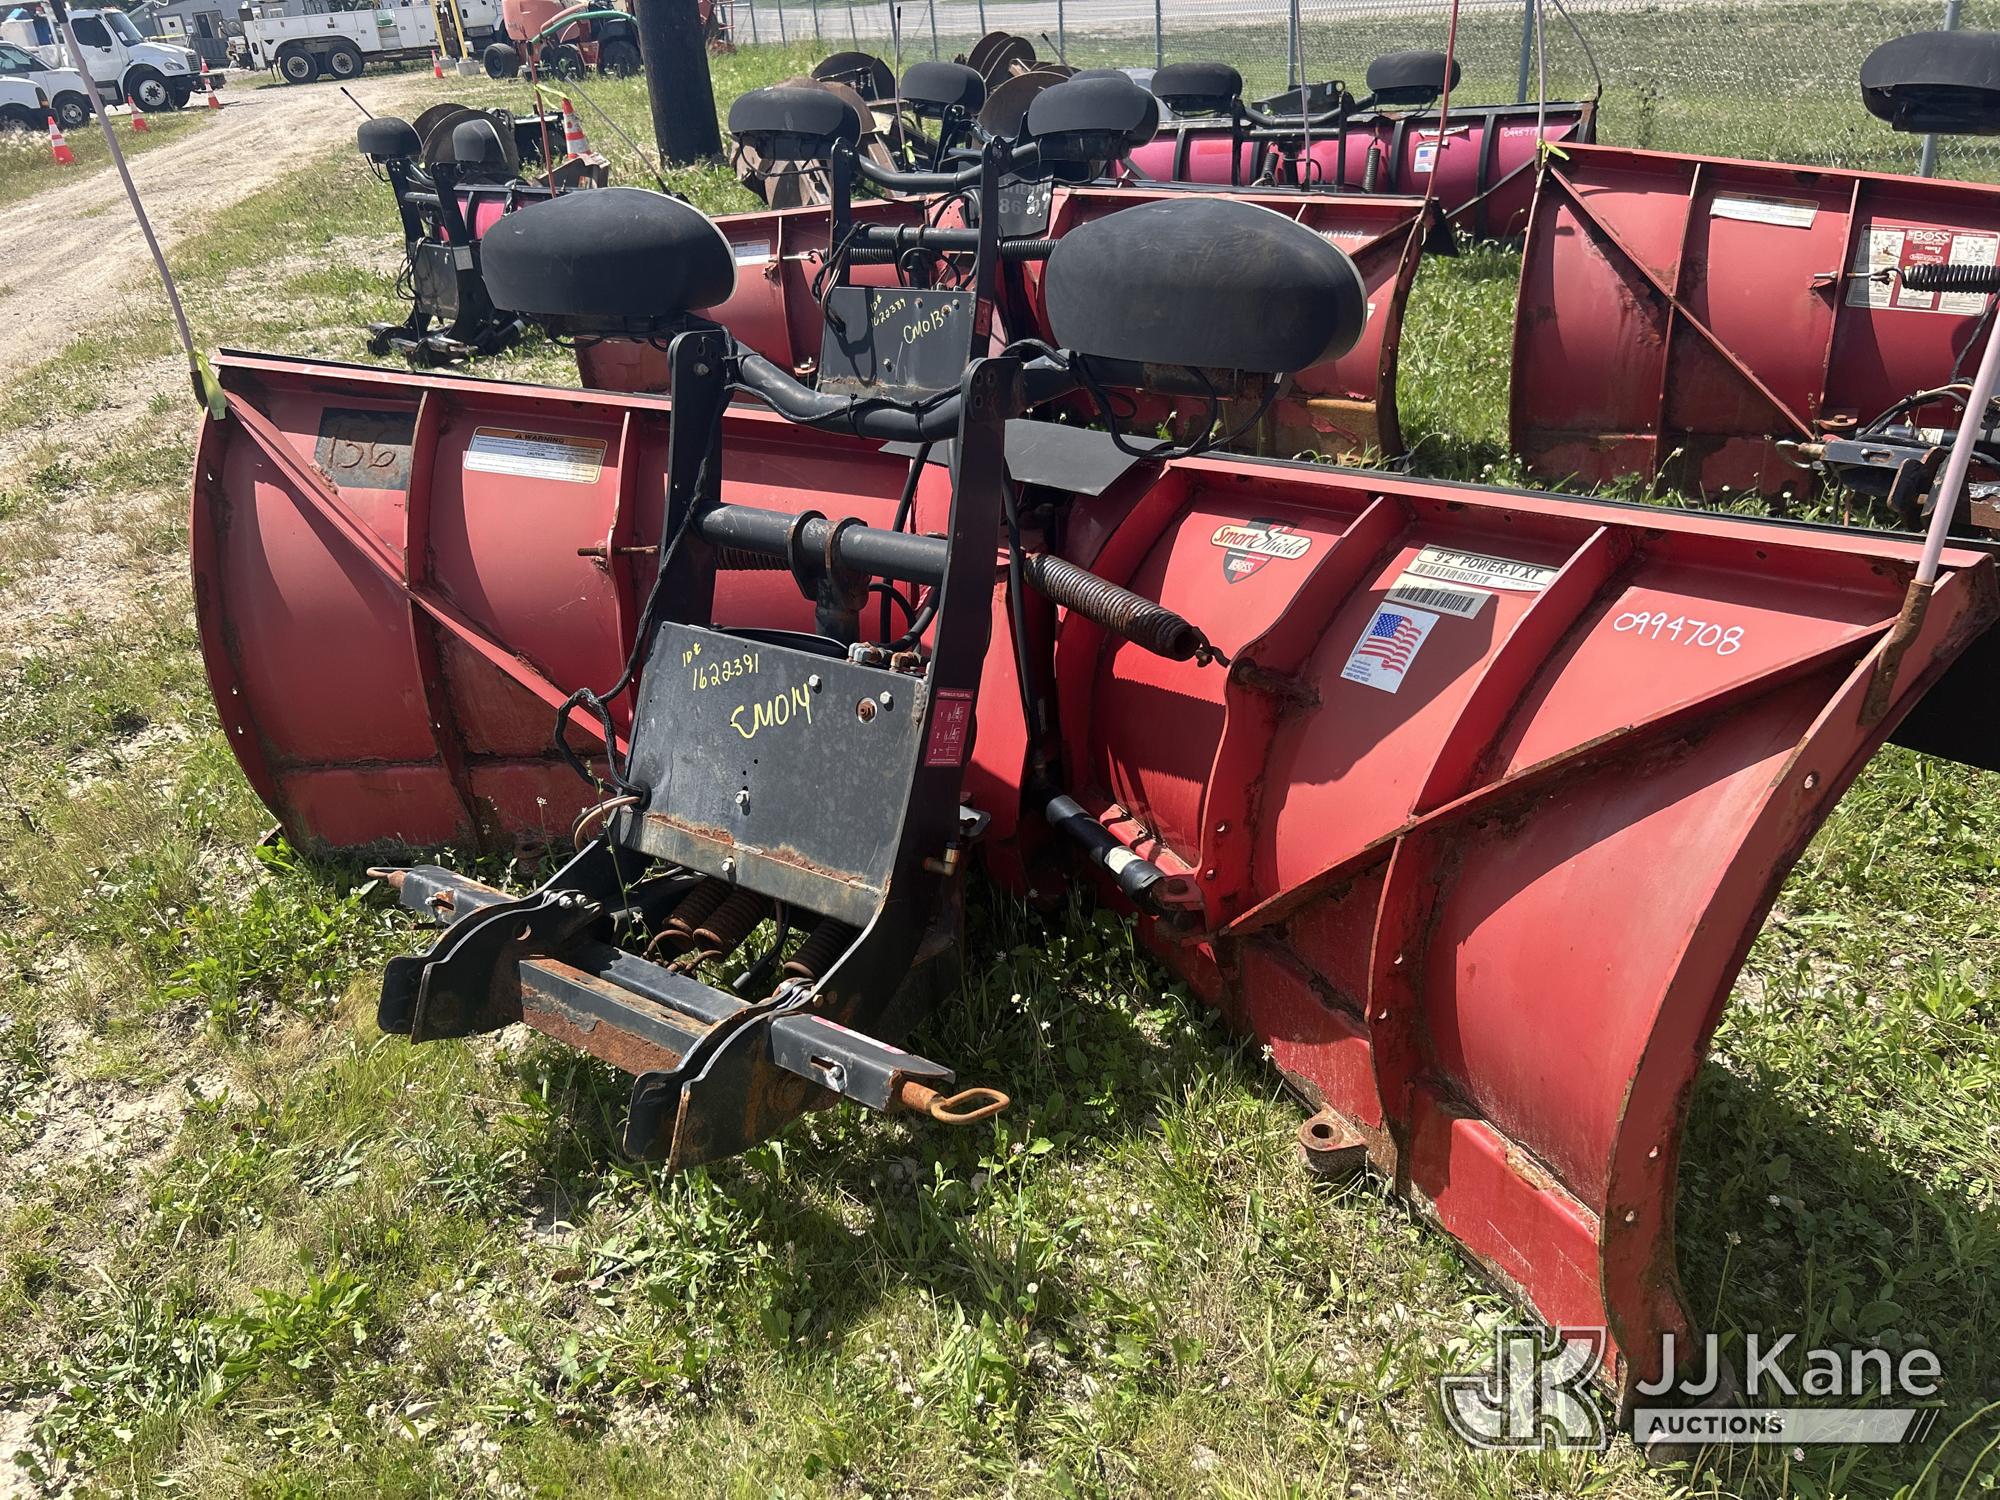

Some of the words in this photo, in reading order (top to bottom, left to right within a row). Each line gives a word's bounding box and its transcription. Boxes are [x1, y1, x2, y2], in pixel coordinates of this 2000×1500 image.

[524, 433, 565, 444] WARNING
[1520, 567, 1545, 581] XT
[1613, 611, 1745, 656] 0994708
[692, 653, 760, 691] 1622391
